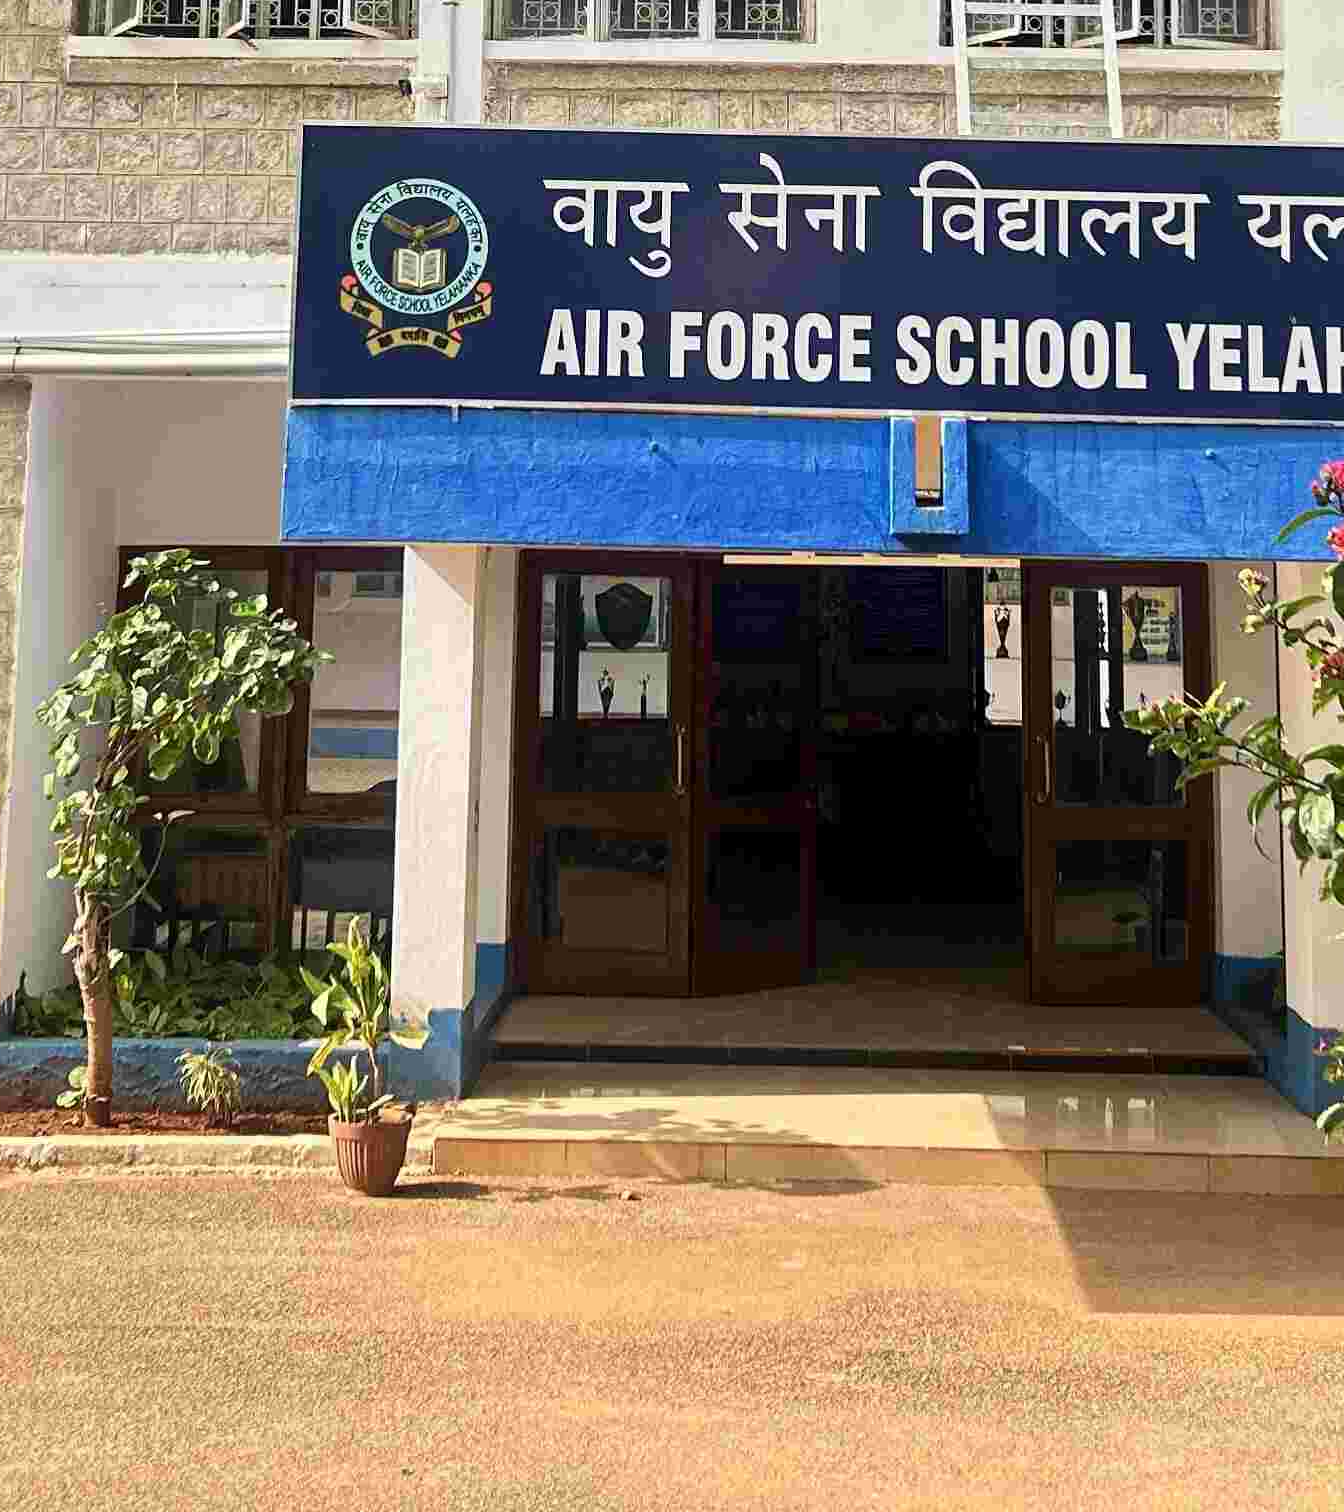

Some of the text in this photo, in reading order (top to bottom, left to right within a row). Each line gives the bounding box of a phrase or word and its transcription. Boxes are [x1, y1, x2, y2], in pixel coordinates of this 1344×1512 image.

[543, 180, 689, 278] वायु
[719, 152, 881, 253] सेना
[909, 160, 1211, 261] विद्यालय
[356, 259, 373, 281] AIR
[369, 276, 399, 305] FORCE
[398, 294, 433, 313] SCHOOL
[434, 261, 482, 307] YELAHANKA
[540, 308, 645, 378] AIR
[669, 310, 872, 383] FORCE
[895, 314, 1147, 390] SCHOOL
